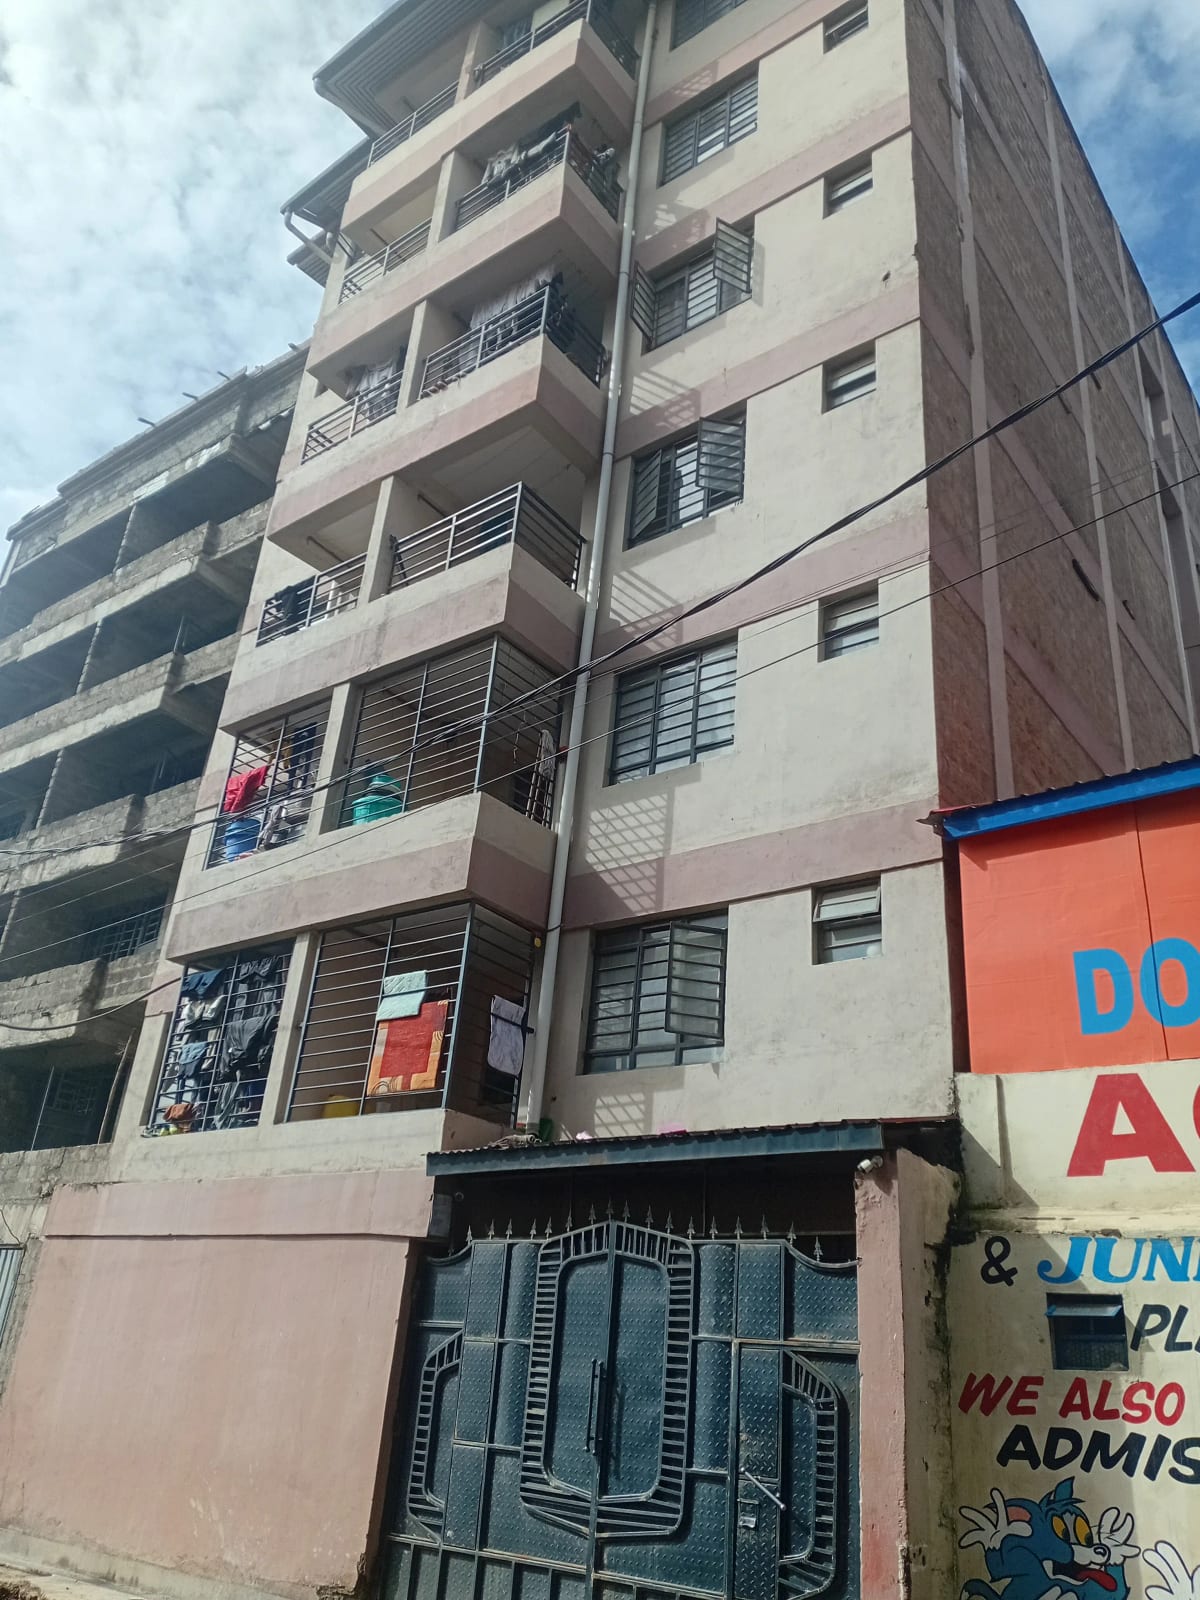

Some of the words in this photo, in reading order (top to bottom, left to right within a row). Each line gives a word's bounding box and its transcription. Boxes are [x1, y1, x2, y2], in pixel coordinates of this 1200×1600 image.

[1067, 1073, 1200, 1177] A
[980, 1235, 1018, 1286] &
[1130, 1304, 1200, 1352] PL
[958, 1372, 1044, 1416] WE
[1059, 1377, 1186, 1426] ALSO
